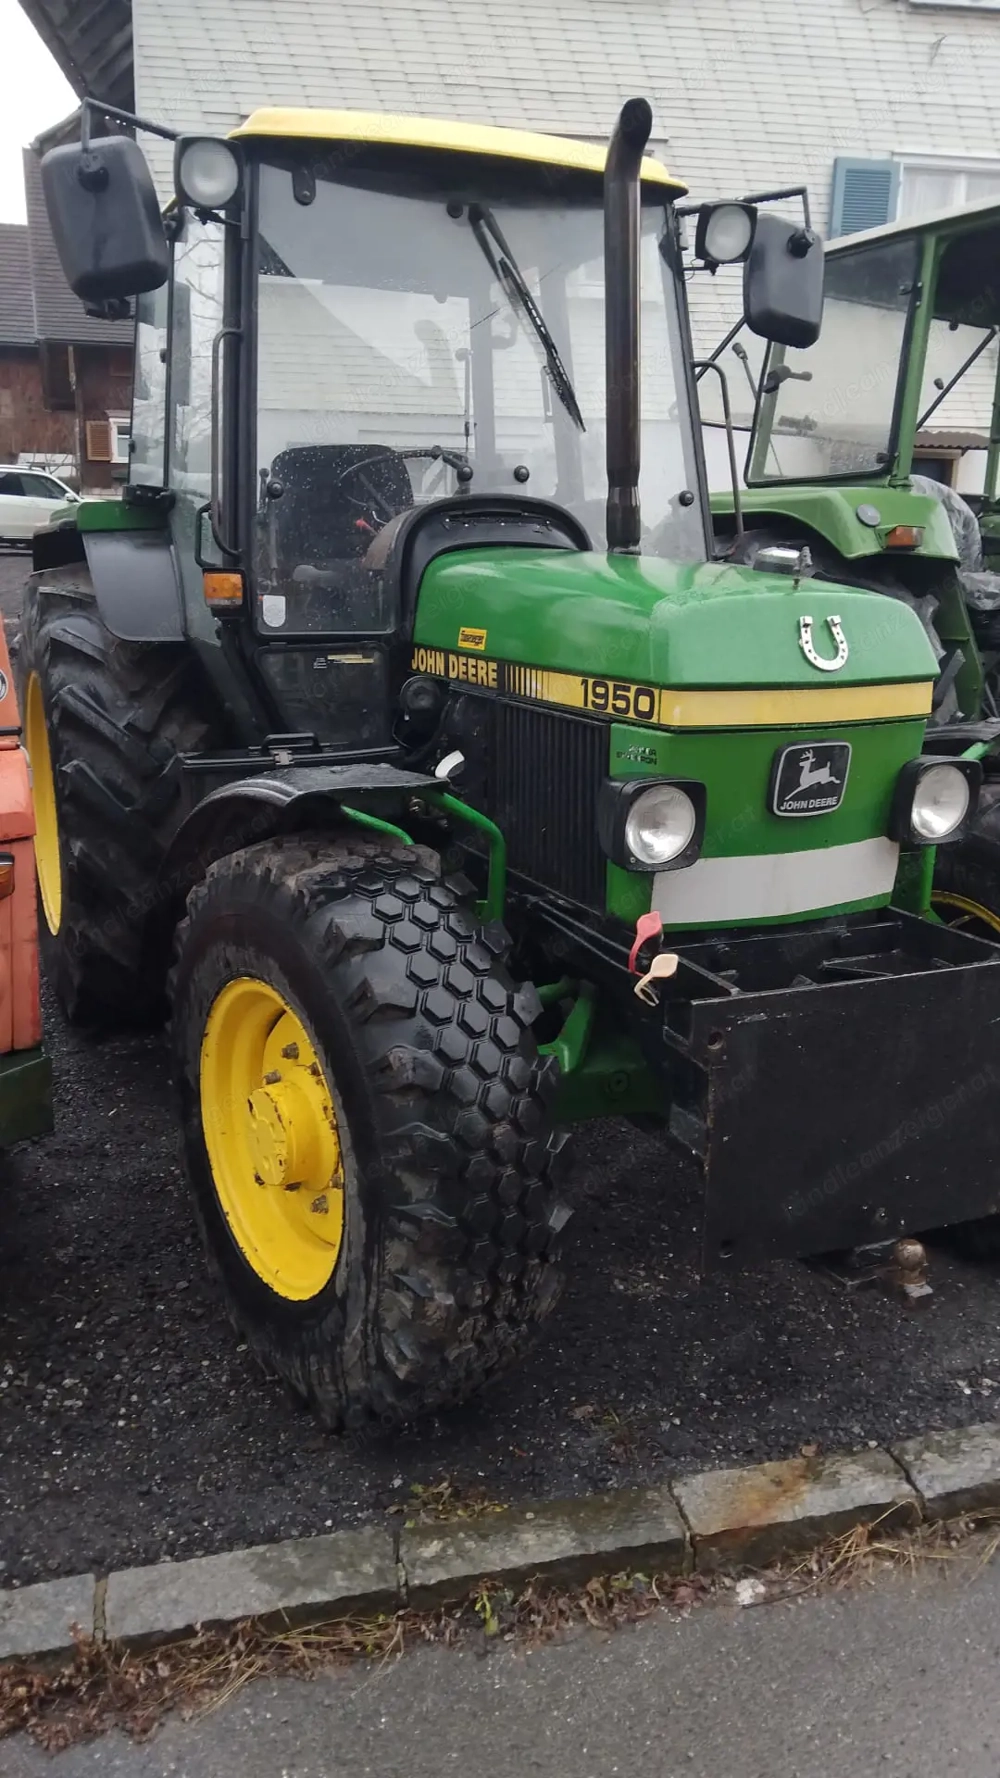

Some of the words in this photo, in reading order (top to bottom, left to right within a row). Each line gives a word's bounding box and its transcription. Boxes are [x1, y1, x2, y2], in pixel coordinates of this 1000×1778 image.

[411, 648, 445, 677] JOHN
[448, 655, 498, 689] DEERE
[581, 680, 655, 720] 1950
[780, 800, 808, 810] JOHN
[808, 797, 838, 809] DEERE
